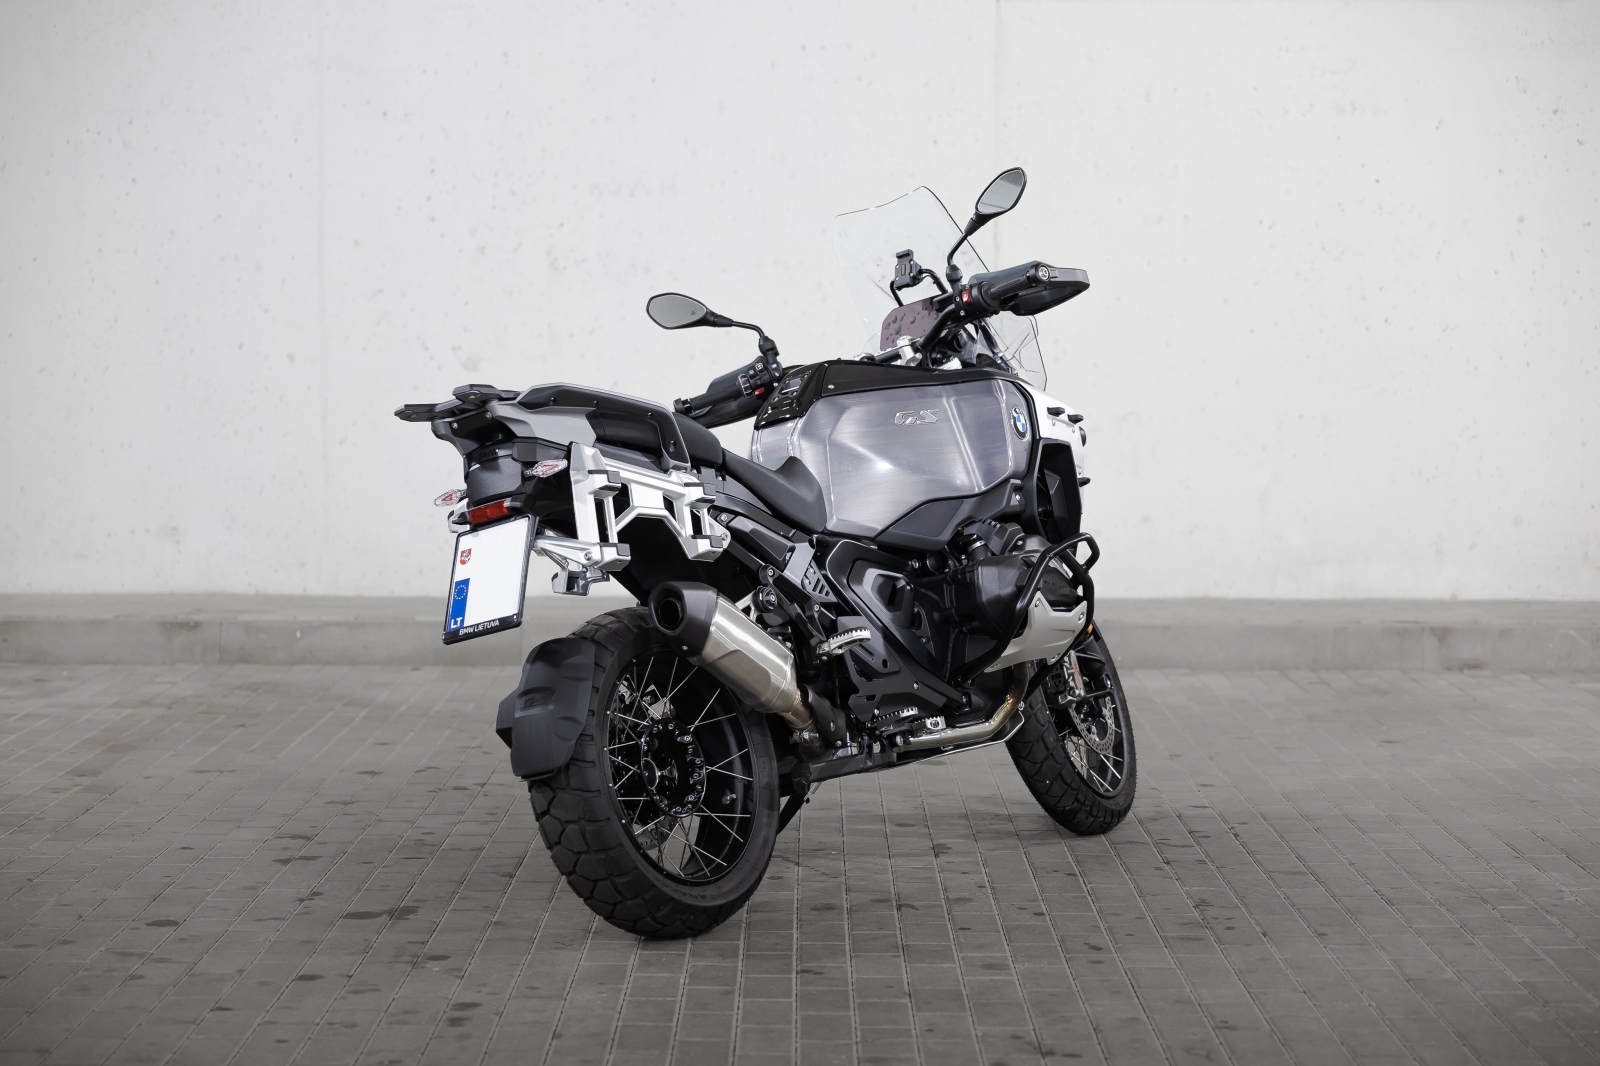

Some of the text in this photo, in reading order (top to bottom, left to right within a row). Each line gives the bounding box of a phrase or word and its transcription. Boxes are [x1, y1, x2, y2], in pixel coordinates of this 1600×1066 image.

[893, 409, 940, 427] GS
[478, 448, 499, 460] BMW
[451, 616, 463, 628] LT
[459, 619, 500, 636] BMW LIETUVA
